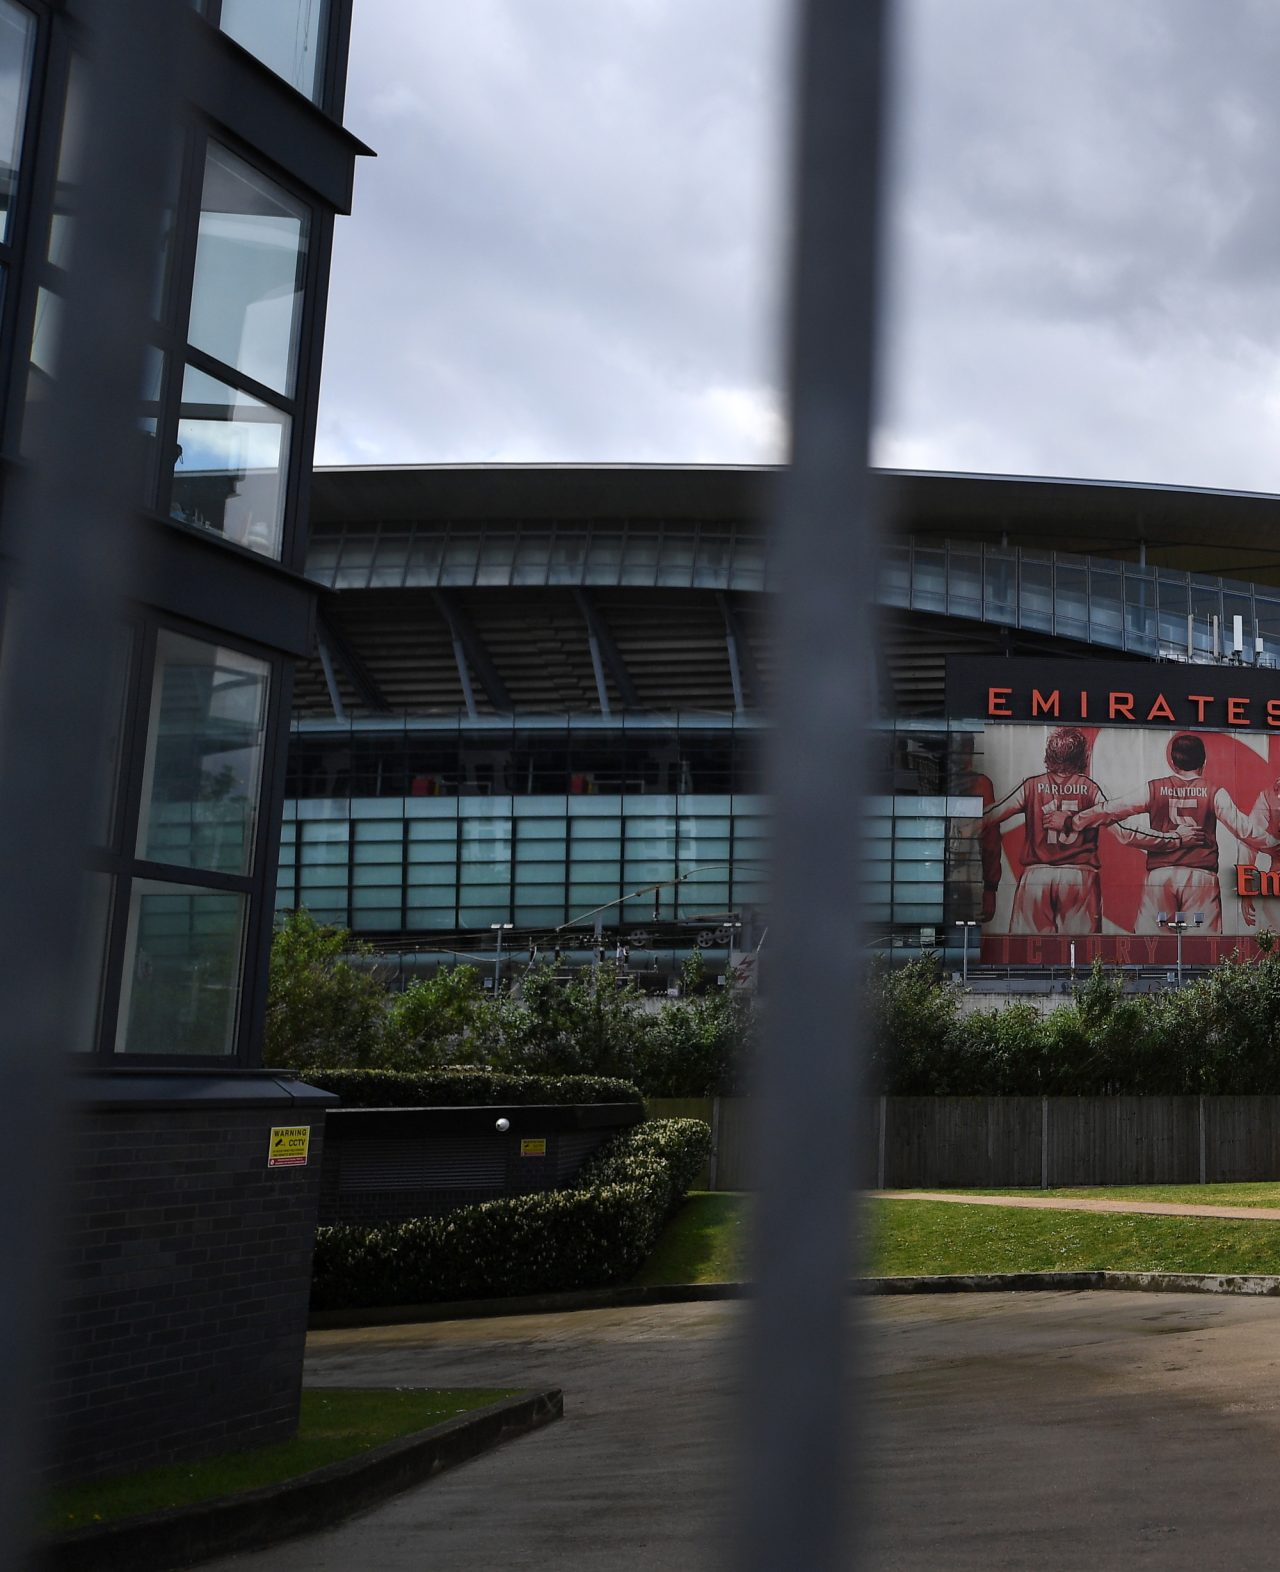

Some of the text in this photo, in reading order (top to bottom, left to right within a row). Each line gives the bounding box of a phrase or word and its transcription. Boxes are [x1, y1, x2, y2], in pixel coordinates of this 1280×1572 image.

[1037, 783, 1088, 796] PARLOUR
[1160, 786, 1208, 798] McLINTOCK
[981, 936, 1160, 964] ICTORY
[289, 1138, 305, 1146] CCTV
